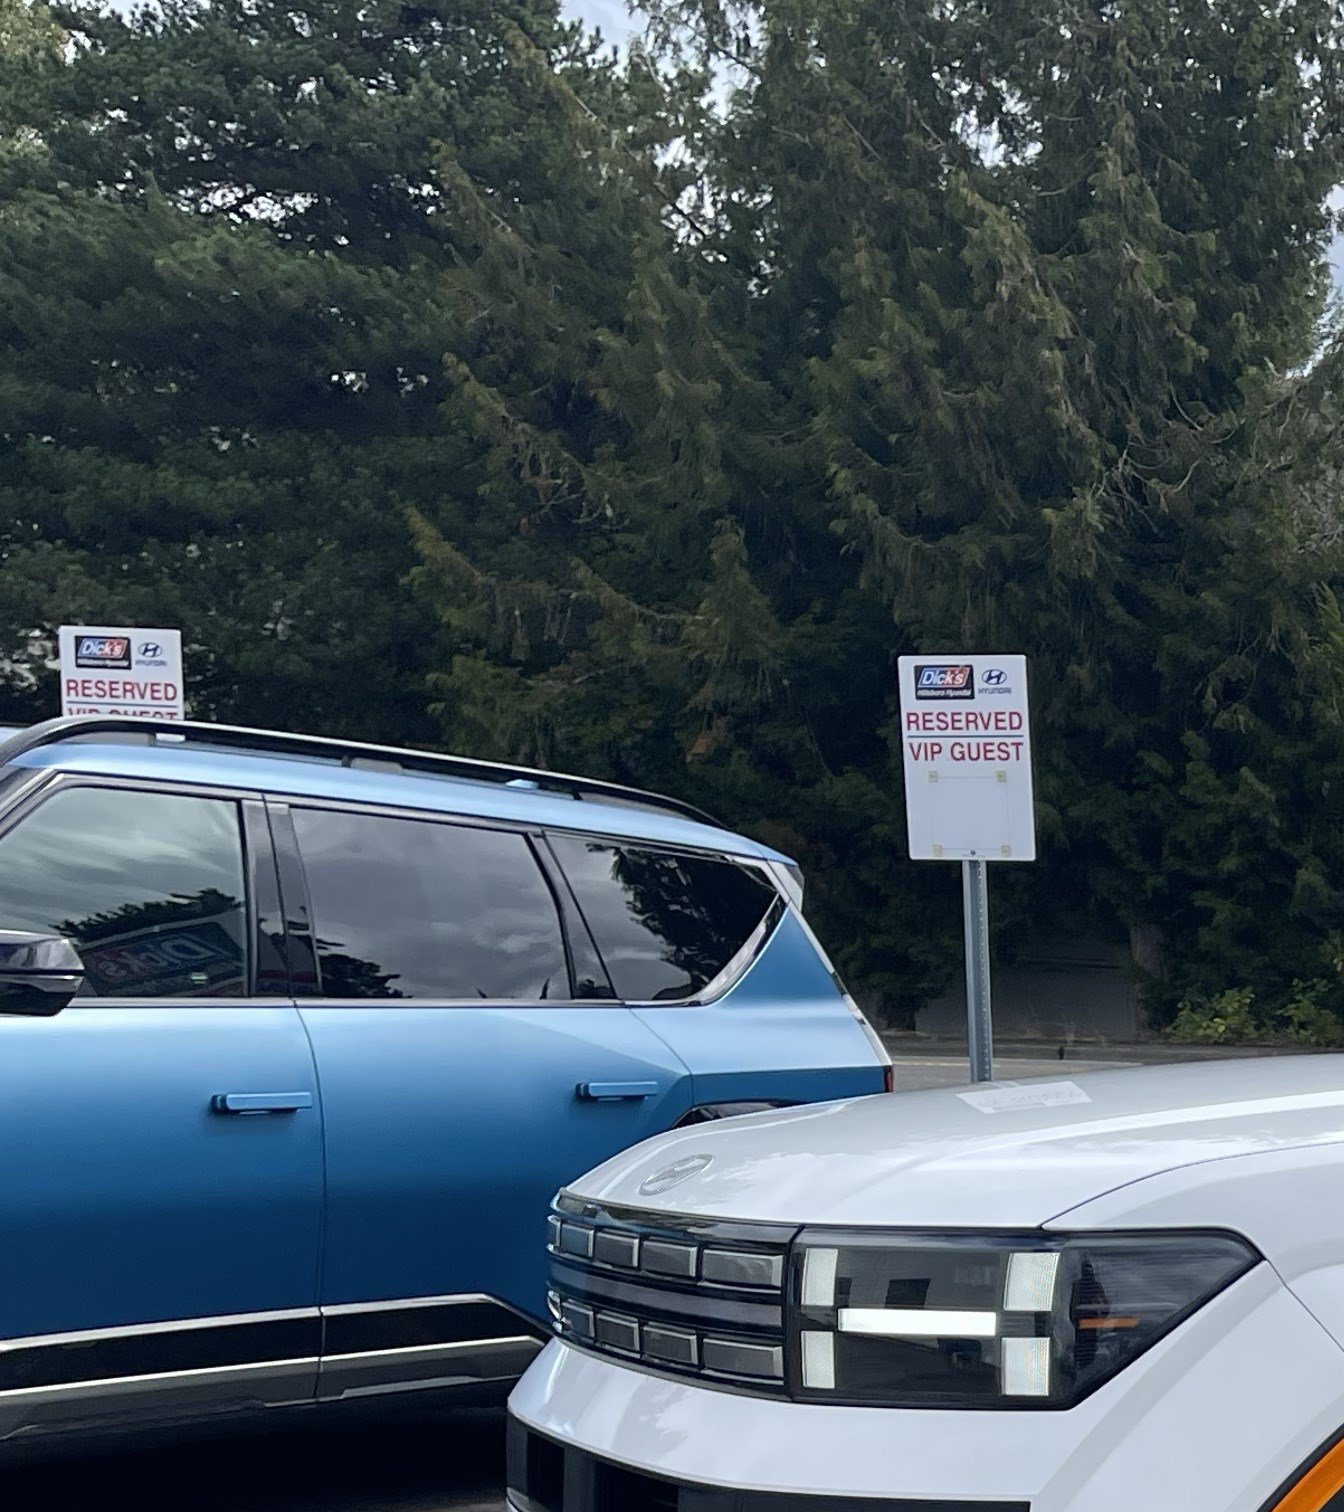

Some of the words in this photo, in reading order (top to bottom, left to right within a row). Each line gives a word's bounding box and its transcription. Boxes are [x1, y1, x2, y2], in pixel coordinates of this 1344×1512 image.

[66, 679, 178, 701] RESERVED
[906, 711, 1023, 731] RESERVED
[909, 742, 943, 761] VIP
[950, 741, 1024, 761] GUEST
